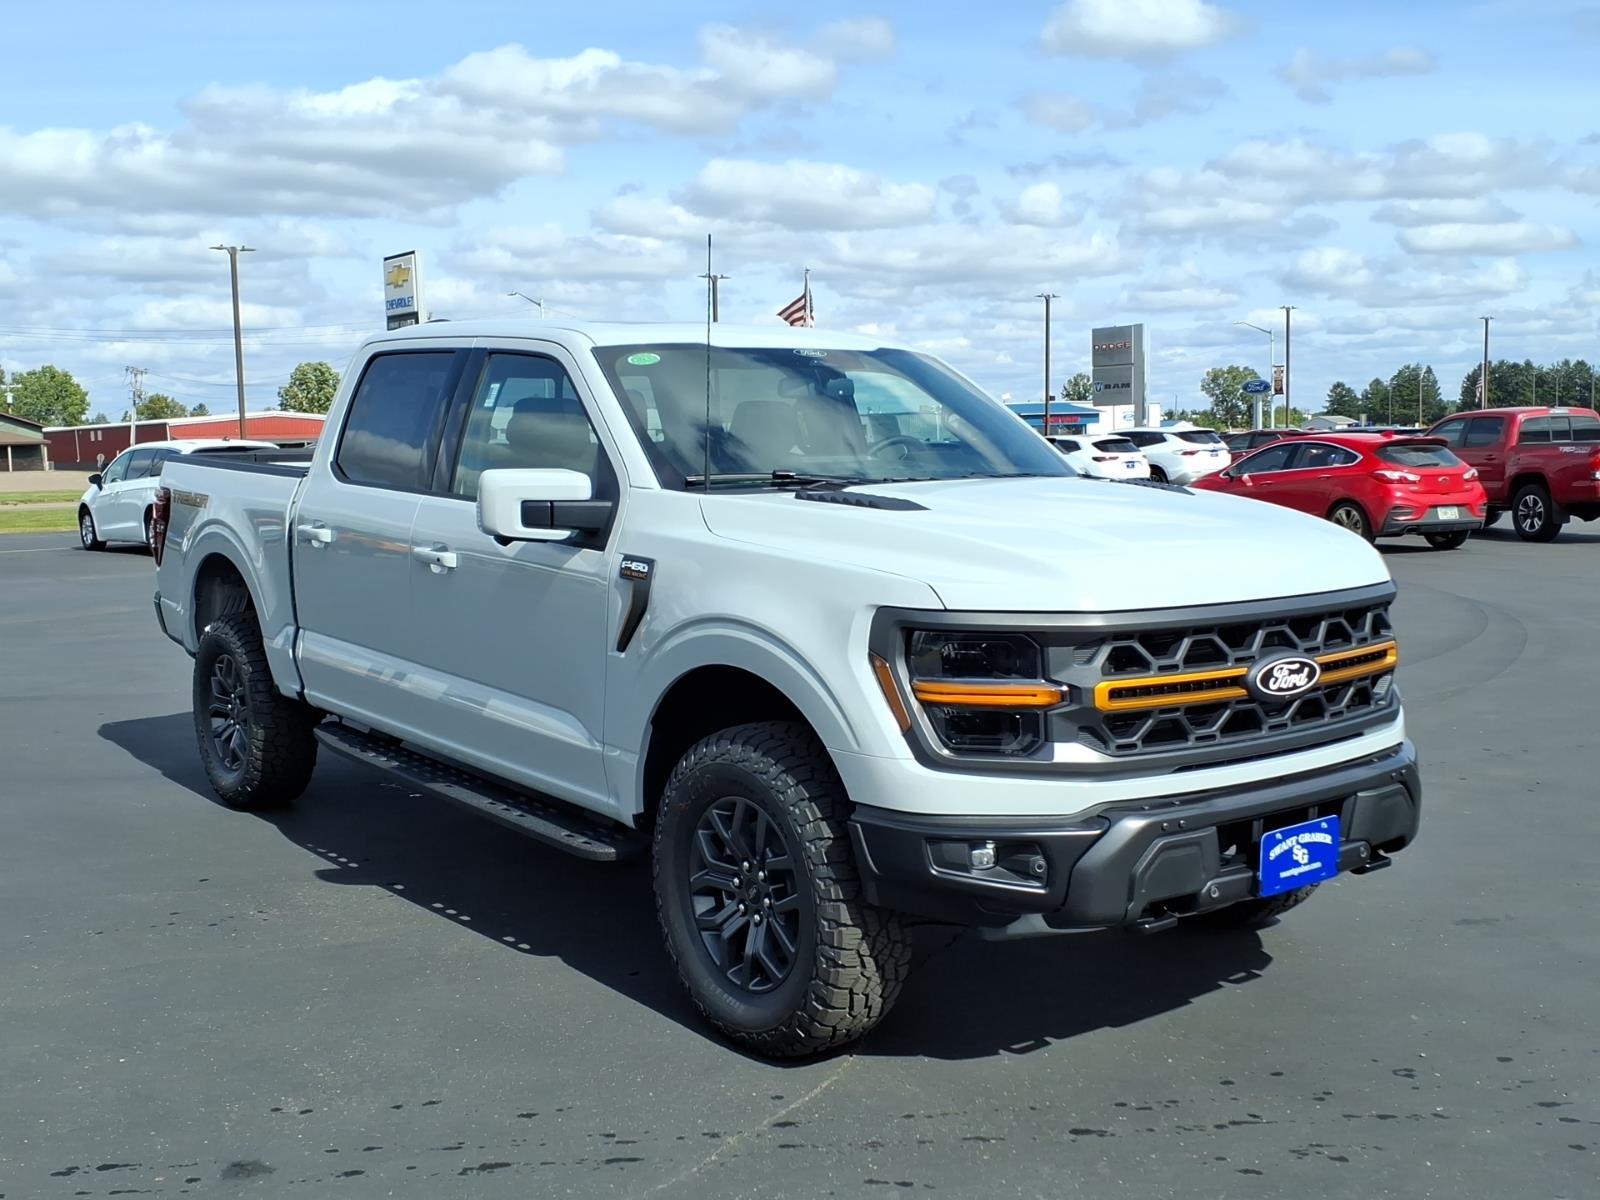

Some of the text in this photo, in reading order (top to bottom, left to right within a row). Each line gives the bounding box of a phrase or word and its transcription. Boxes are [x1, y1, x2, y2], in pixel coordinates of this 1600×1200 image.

[385, 296, 414, 311] CHEVROLET
[1093, 342, 1132, 351] DODGE
[1104, 382, 1131, 390] RAM
[1246, 382, 1266, 392] Ford
[171, 488, 209, 509] TREMOR
[1268, 662, 1310, 691] Ford
[1268, 831, 1333, 861] SWANT GRABER
[1292, 844, 1309, 865] SG
